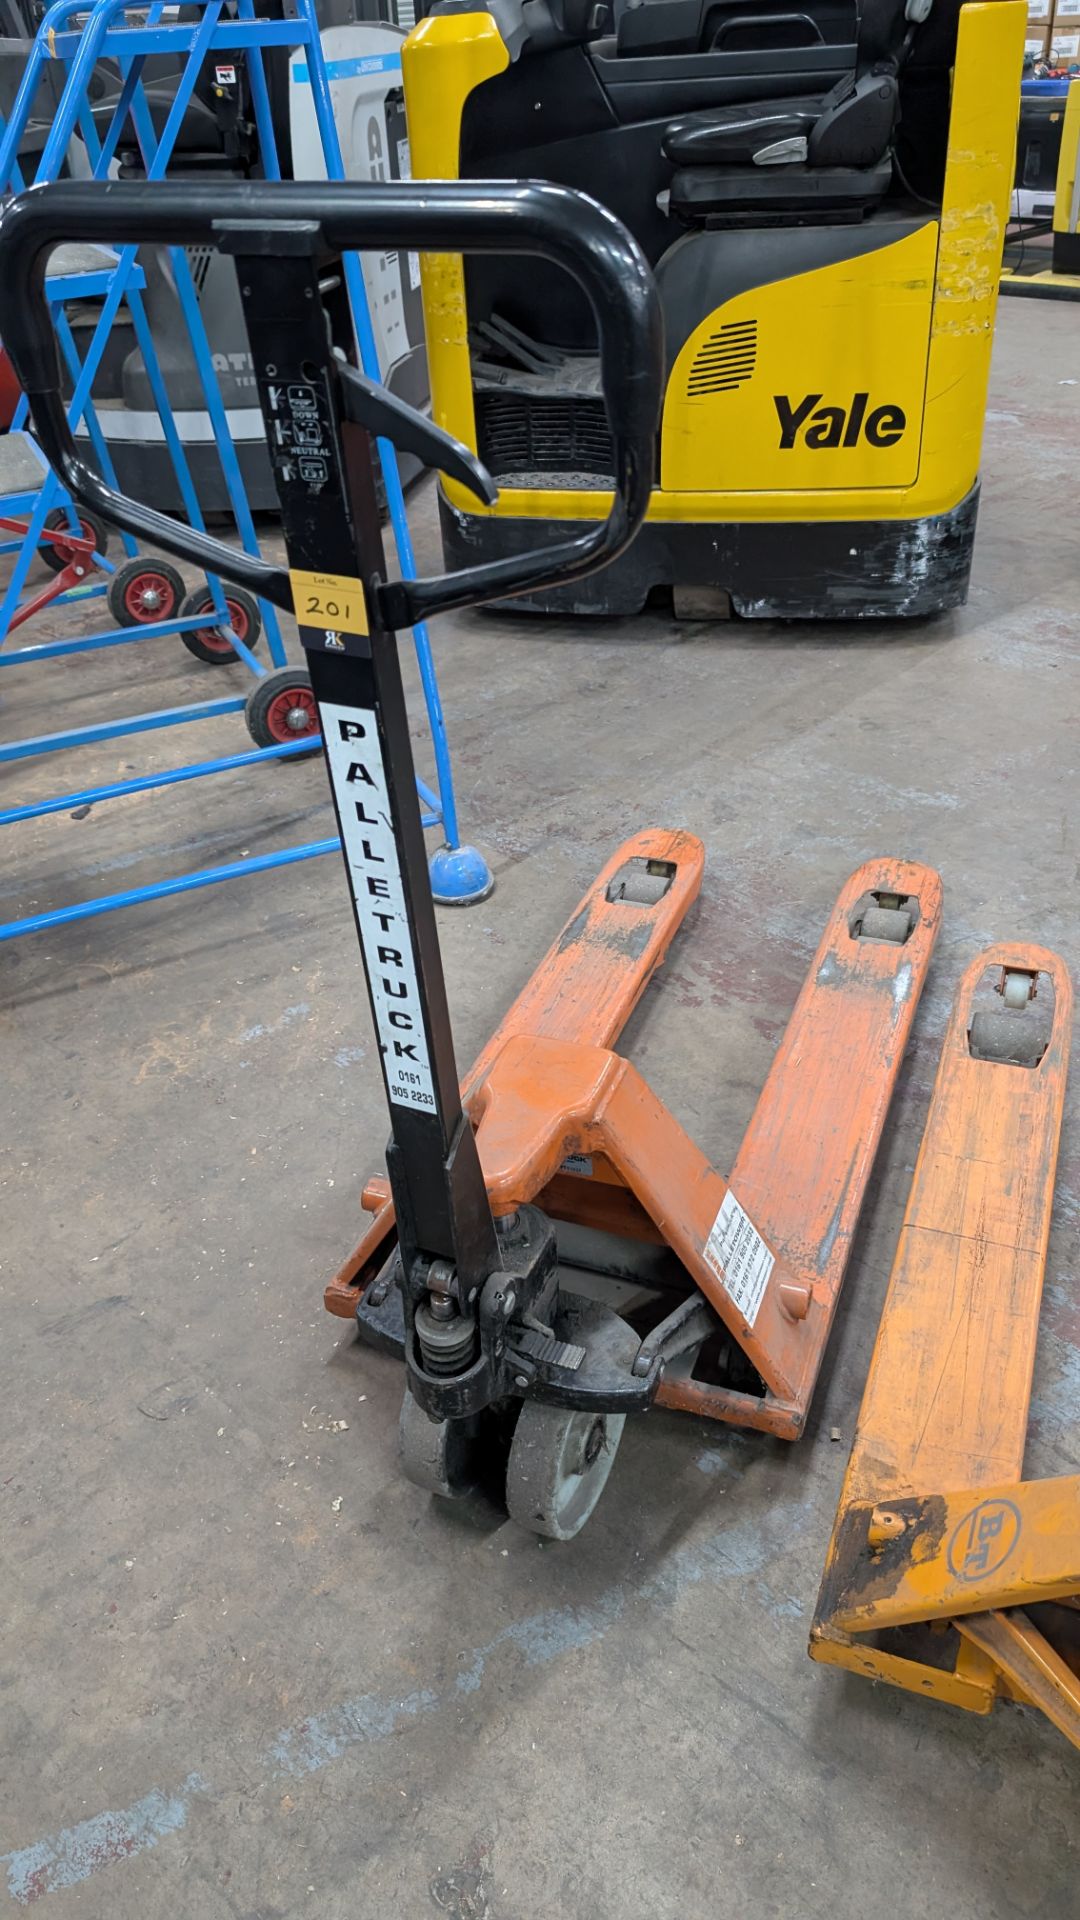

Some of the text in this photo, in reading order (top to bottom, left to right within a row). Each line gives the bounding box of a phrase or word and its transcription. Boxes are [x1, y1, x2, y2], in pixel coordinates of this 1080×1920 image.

[292, 411, 319, 420] DOWN
[773, 392, 906, 449] Yale
[291, 446, 332, 457] NEUTRAL
[306, 597, 349, 619] 201
[398, 1070, 421, 1086] 0161
[391, 1085, 434, 1106] 905 2233
[722, 1215, 745, 1272] PALLETOWER
[963, 1511, 1004, 1570] BT
